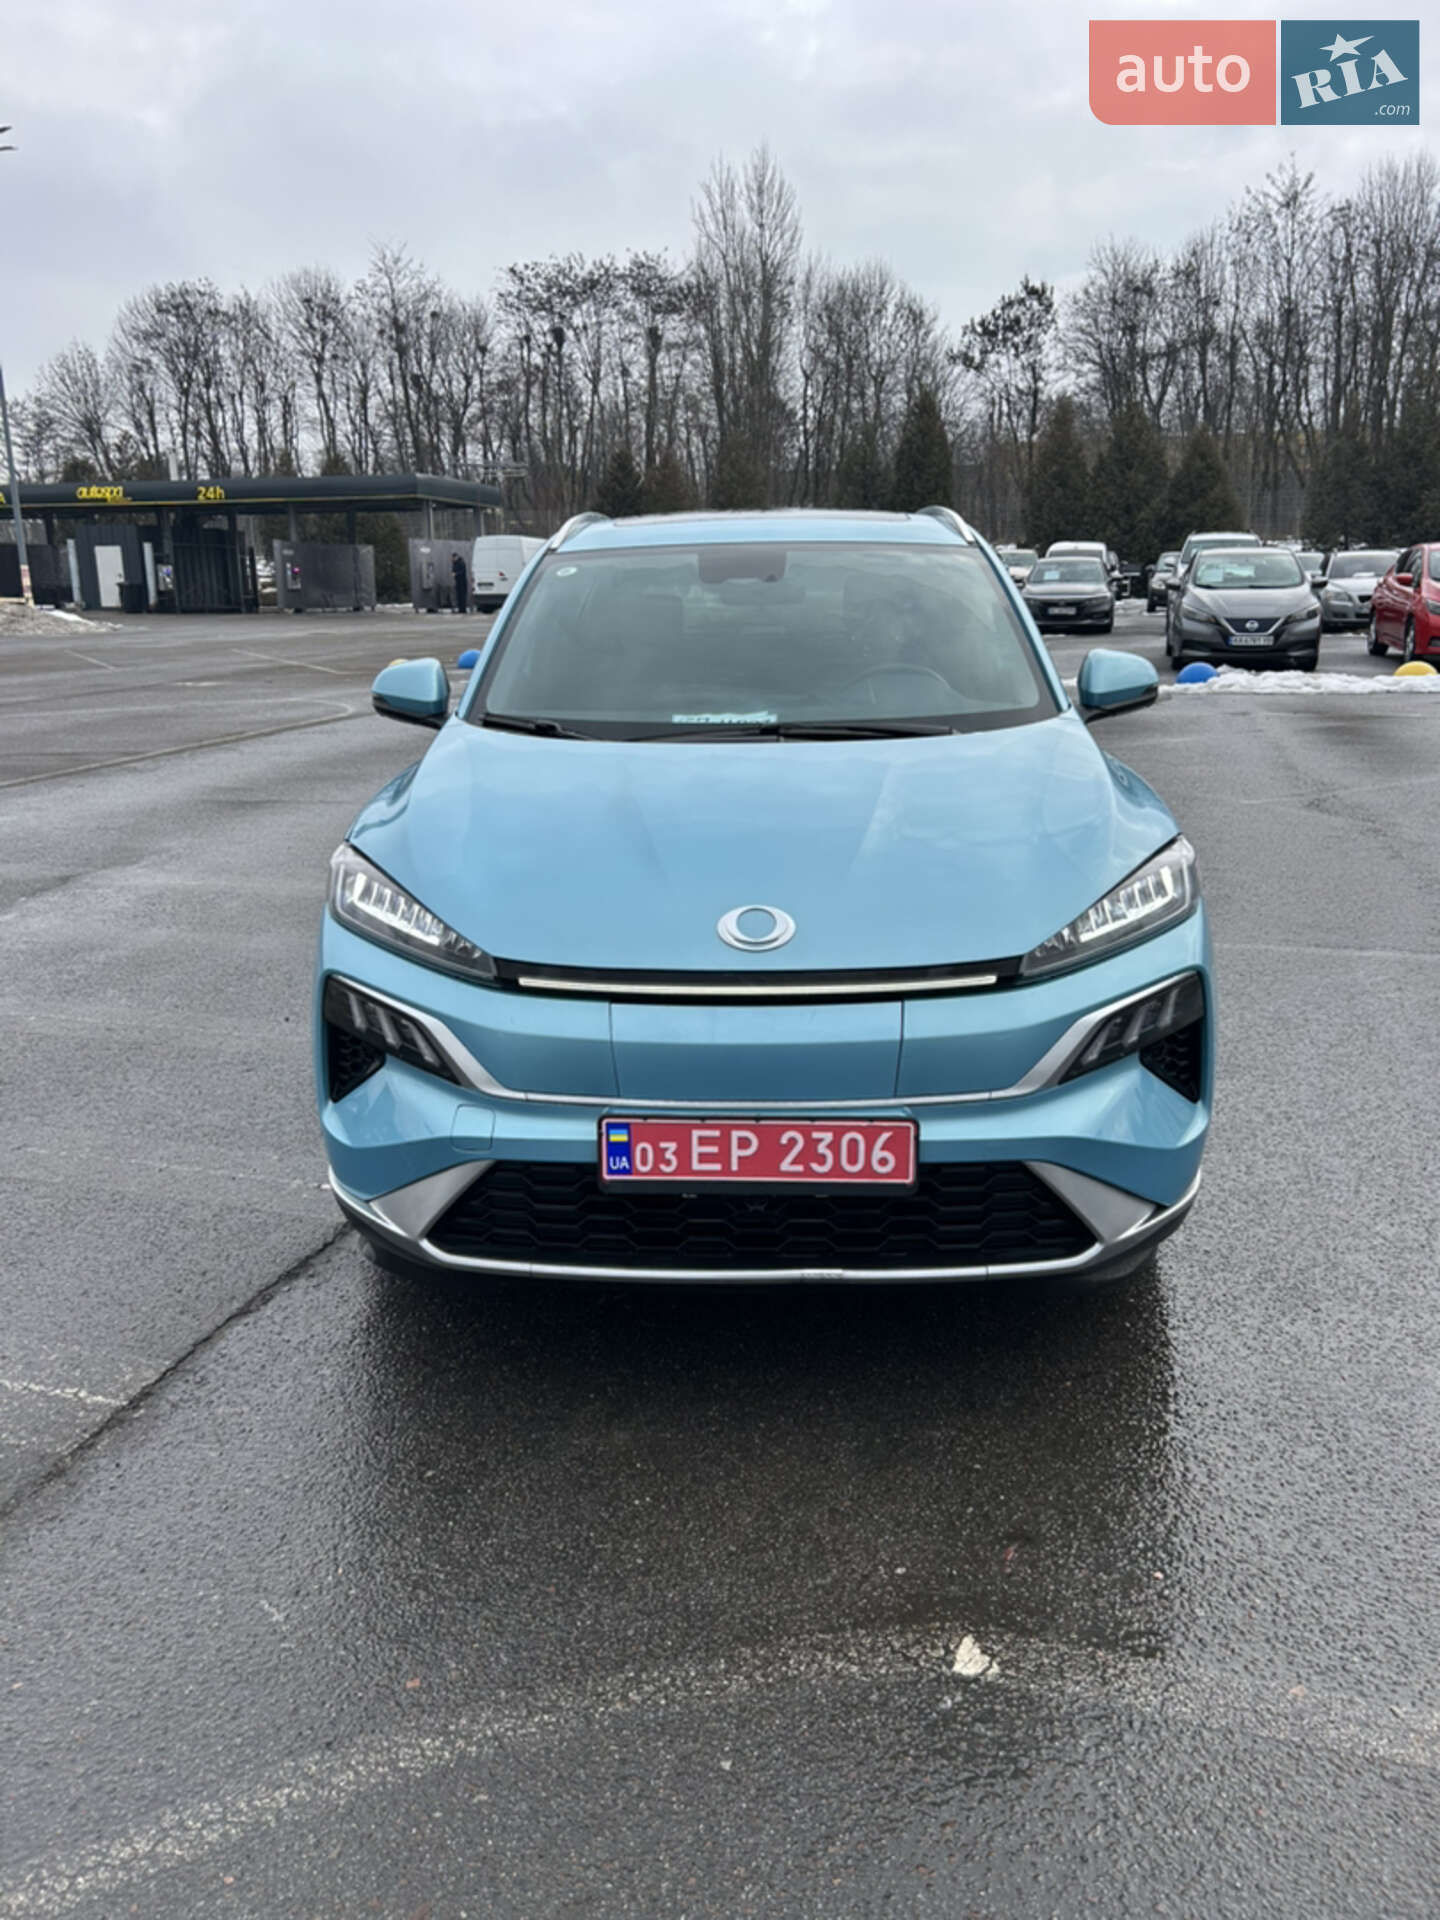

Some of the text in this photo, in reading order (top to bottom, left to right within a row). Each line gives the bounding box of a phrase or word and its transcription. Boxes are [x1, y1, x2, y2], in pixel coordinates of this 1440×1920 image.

[197, 486, 225, 500] 24h
[635, 1129, 896, 1174] 03 EP 2306
[609, 1156, 630, 1171] UA
